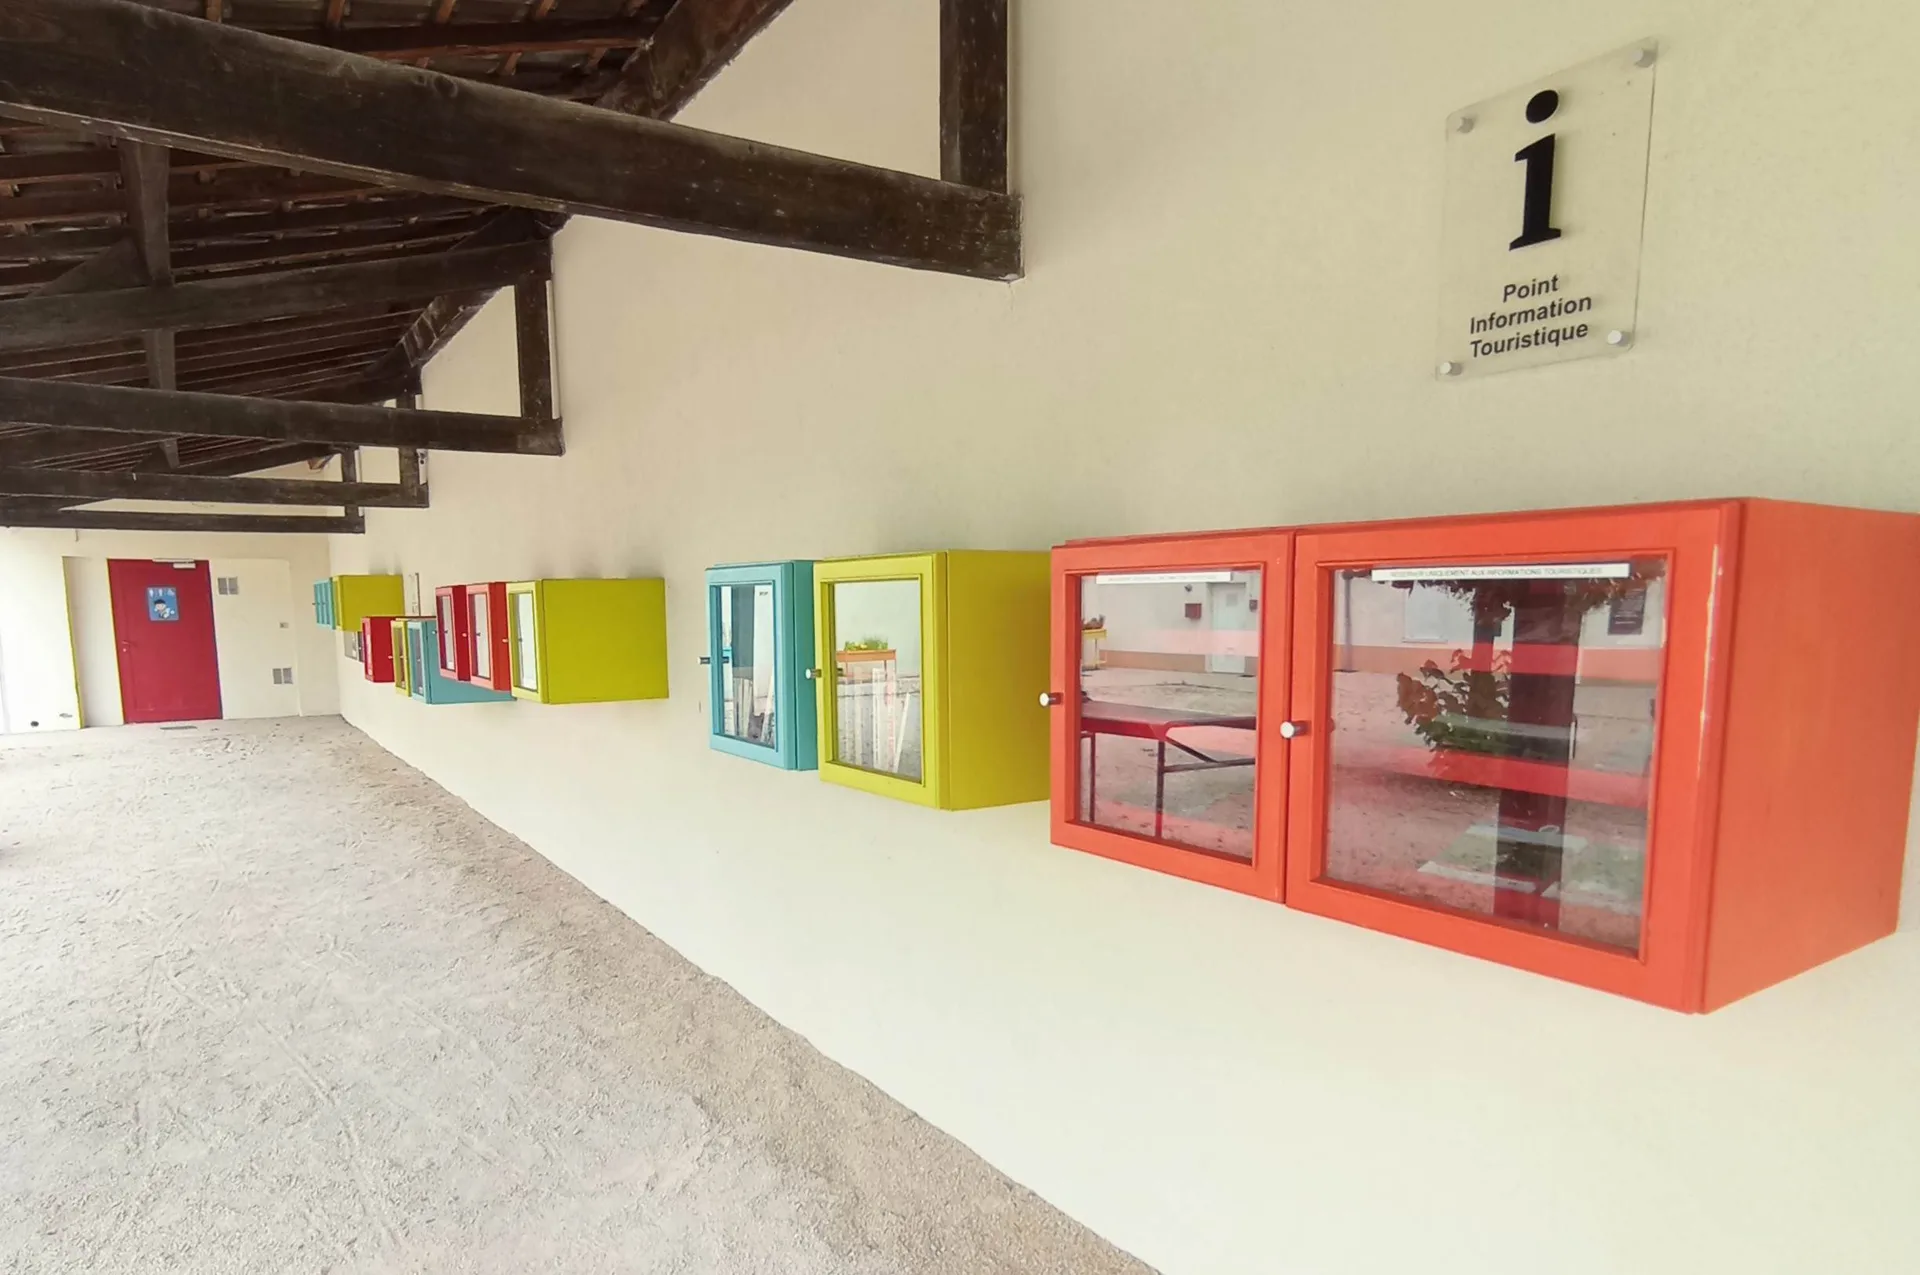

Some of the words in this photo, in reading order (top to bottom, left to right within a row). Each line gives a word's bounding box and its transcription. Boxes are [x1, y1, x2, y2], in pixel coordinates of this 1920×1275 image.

[1508, 89, 1562, 251] i
[1503, 274, 1559, 303] Point
[1470, 296, 1592, 335] Information
[1470, 322, 1589, 359] Touristique
[1487, 568, 1542, 577] INFORMATIONS
[1544, 567, 1603, 576] TOURISTIQUES
